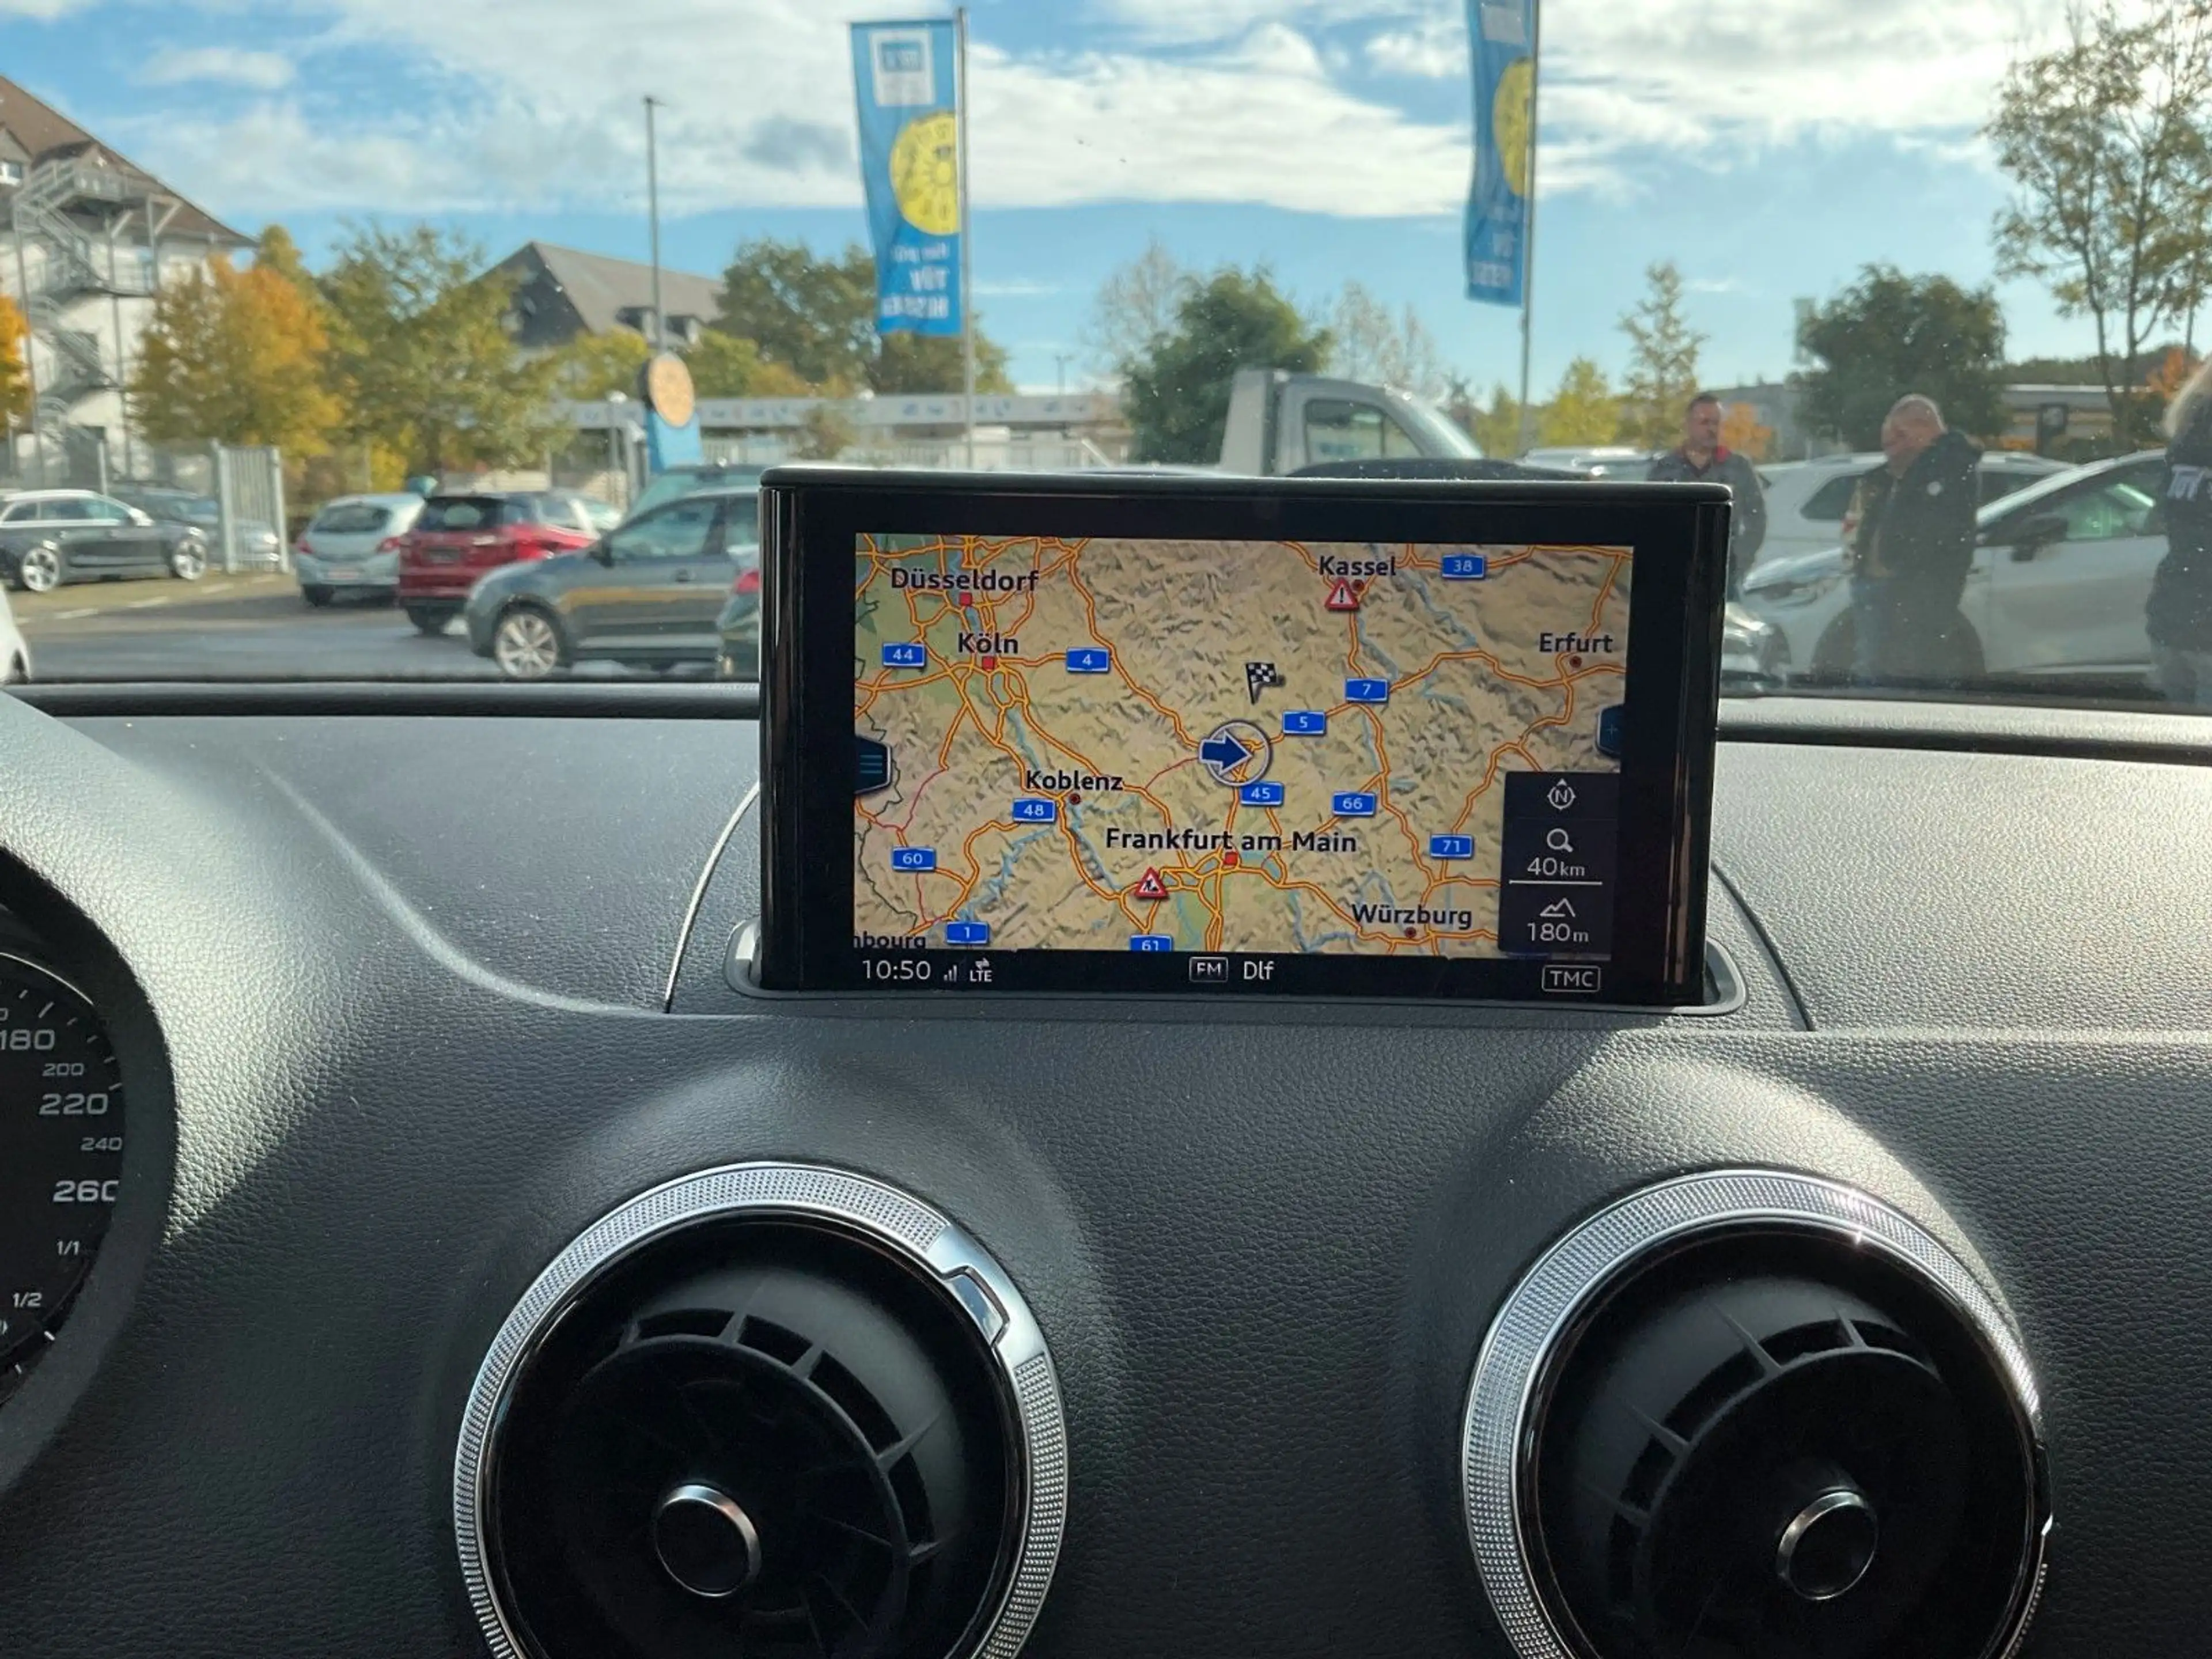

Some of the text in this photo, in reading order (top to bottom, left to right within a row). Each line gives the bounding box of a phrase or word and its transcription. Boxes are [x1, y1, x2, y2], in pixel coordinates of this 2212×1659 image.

[1320, 555, 1396, 576] Kassel
[1453, 559, 1473, 573] 38
[892, 569, 1039, 591] Düsseldorf
[958, 632, 1018, 654] Köln
[1540, 632, 1612, 653] Erfurt
[892, 649, 914, 662] 44
[1082, 654, 1093, 666] 4
[1362, 684, 1371, 696] 7
[1298, 716, 1308, 729] 5
[1026, 770, 1123, 792] Koblenz
[1250, 787, 1271, 800] 45
[1342, 797, 1363, 810] 66
[1023, 805, 1044, 817] 48
[1106, 828, 1357, 851] Frankfurt am Main
[1442, 840, 1461, 853] 71
[902, 853, 923, 865] 60
[1352, 904, 1472, 929] Würzburg
[964, 927, 971, 940] 1
[1142, 940, 1159, 951] 61
[863, 959, 930, 980] 10:50
[969, 969, 993, 982] LTE
[1196, 961, 1221, 976] FM
[1243, 960, 1274, 980] Dlf
[1550, 970, 1593, 987] TMC
[0, 1029, 55, 1050] 180
[42, 1063, 85, 1077] 200
[39, 1093, 109, 1115] 220
[80, 1137, 123, 1151] 240
[56, 1240, 80, 1256] 1/1
[12, 1292, 43, 1308] 1/2
